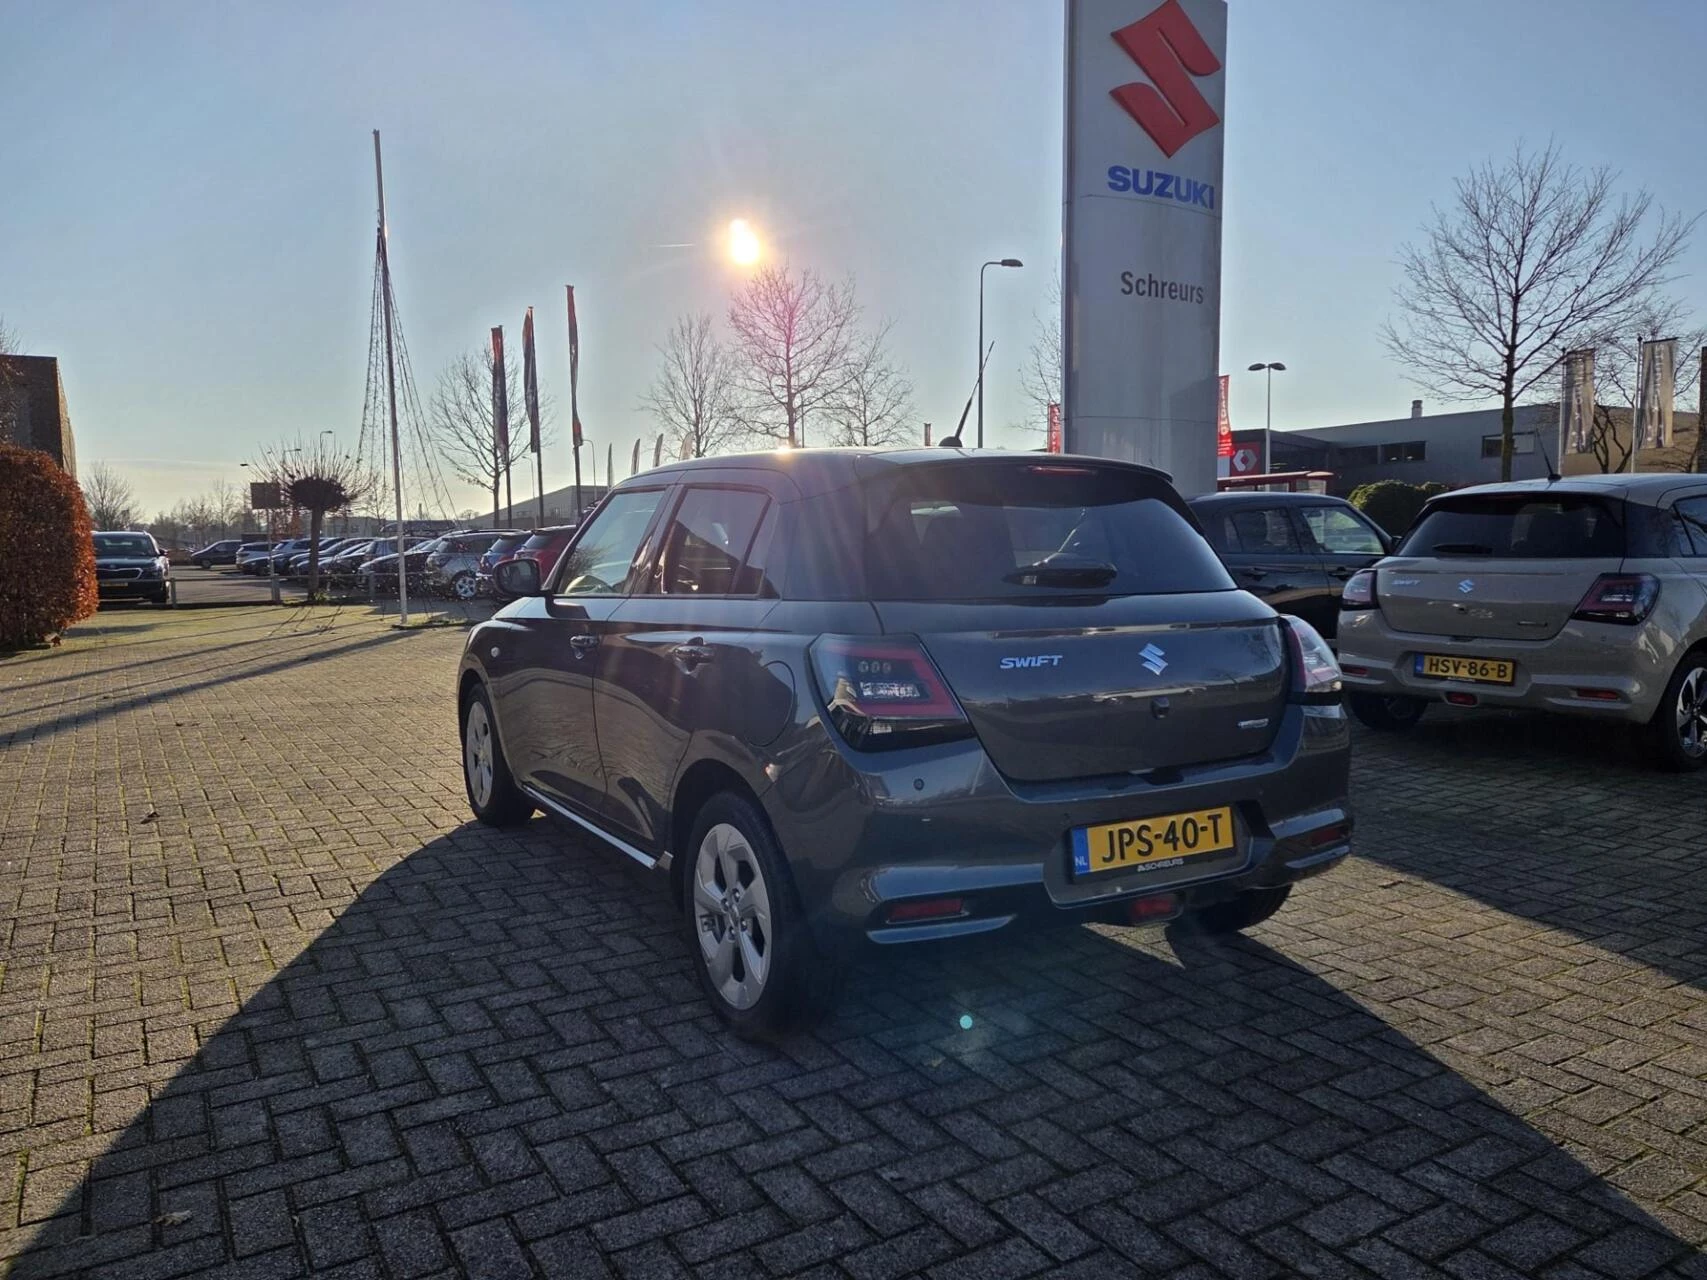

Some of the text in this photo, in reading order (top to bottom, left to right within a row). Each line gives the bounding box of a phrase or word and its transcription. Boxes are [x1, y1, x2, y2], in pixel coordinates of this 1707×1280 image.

[1107, 165, 1215, 210] SUZUKI
[1120, 271, 1204, 305] Schreurs
[999, 654, 1064, 669] SWIFT
[1428, 657, 1508, 678] HSV-86-B
[1102, 813, 1223, 864] JPS-40-T
[1075, 856, 1088, 866] NL
